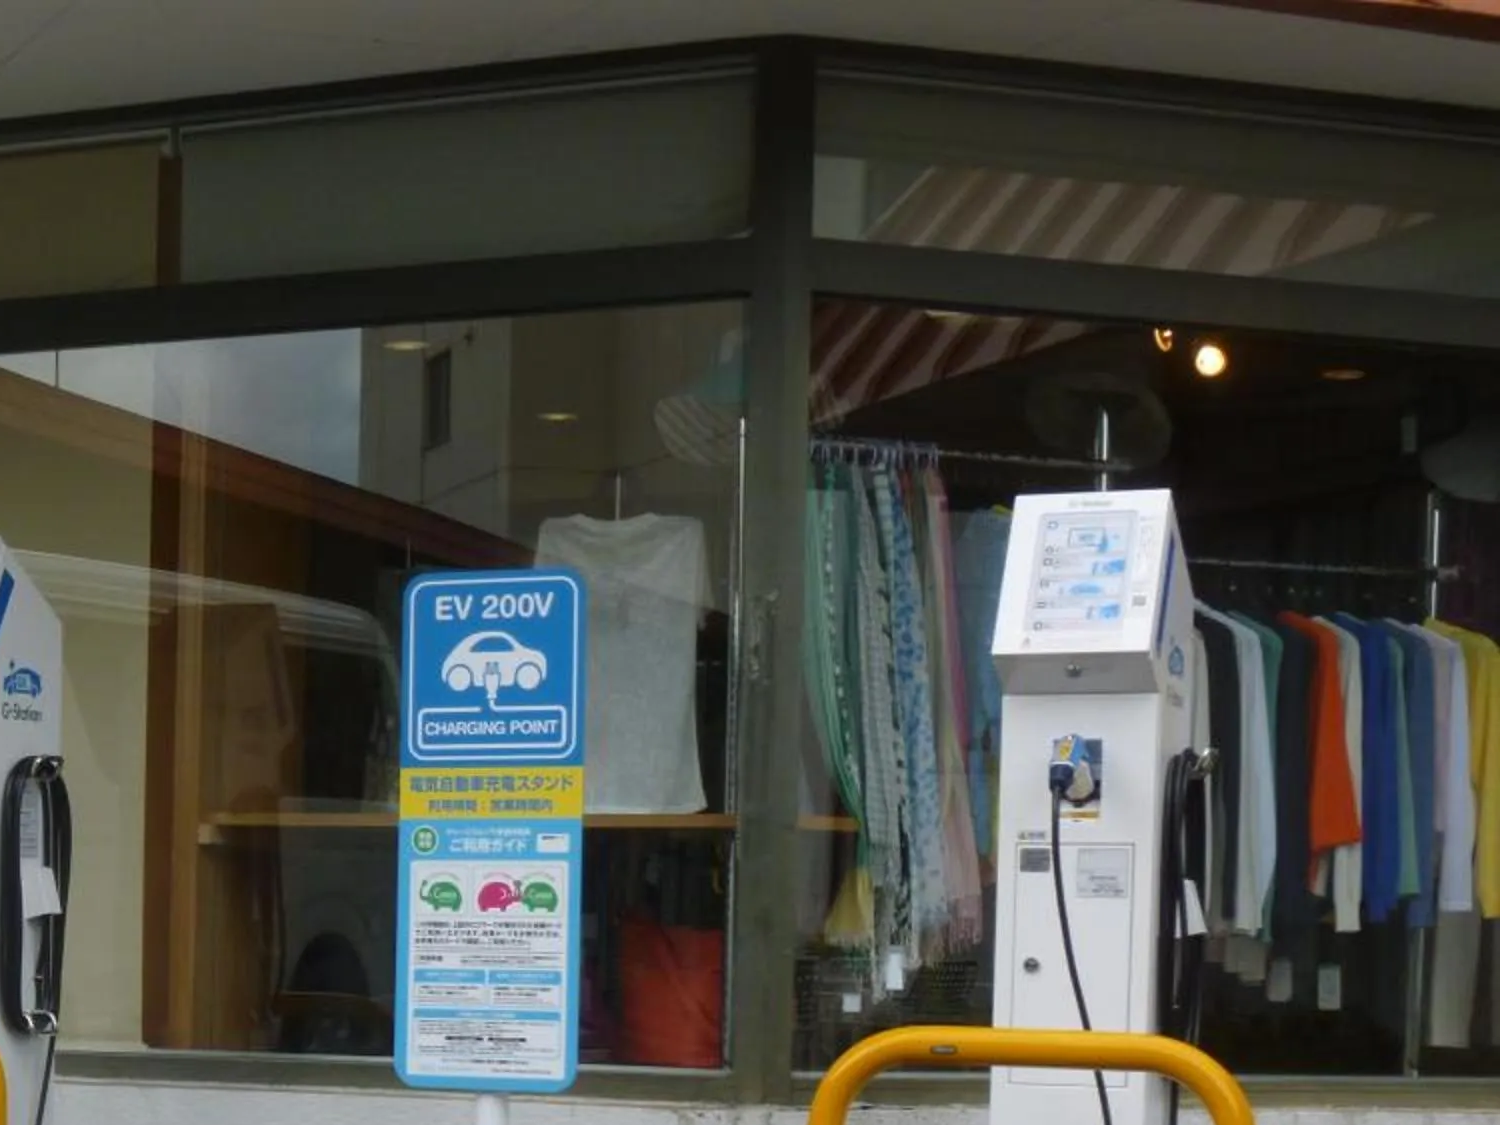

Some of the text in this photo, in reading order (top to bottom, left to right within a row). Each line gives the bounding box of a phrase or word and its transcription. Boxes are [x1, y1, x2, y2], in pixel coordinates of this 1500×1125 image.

[435, 592, 554, 620] EV 200V
[1, 702, 43, 721] G-Station
[424, 719, 558, 736] CHARGING POINT
[410, 775, 573, 792] 電気自動車充電スタンド
[449, 838, 527, 853] ご利用ガイド
